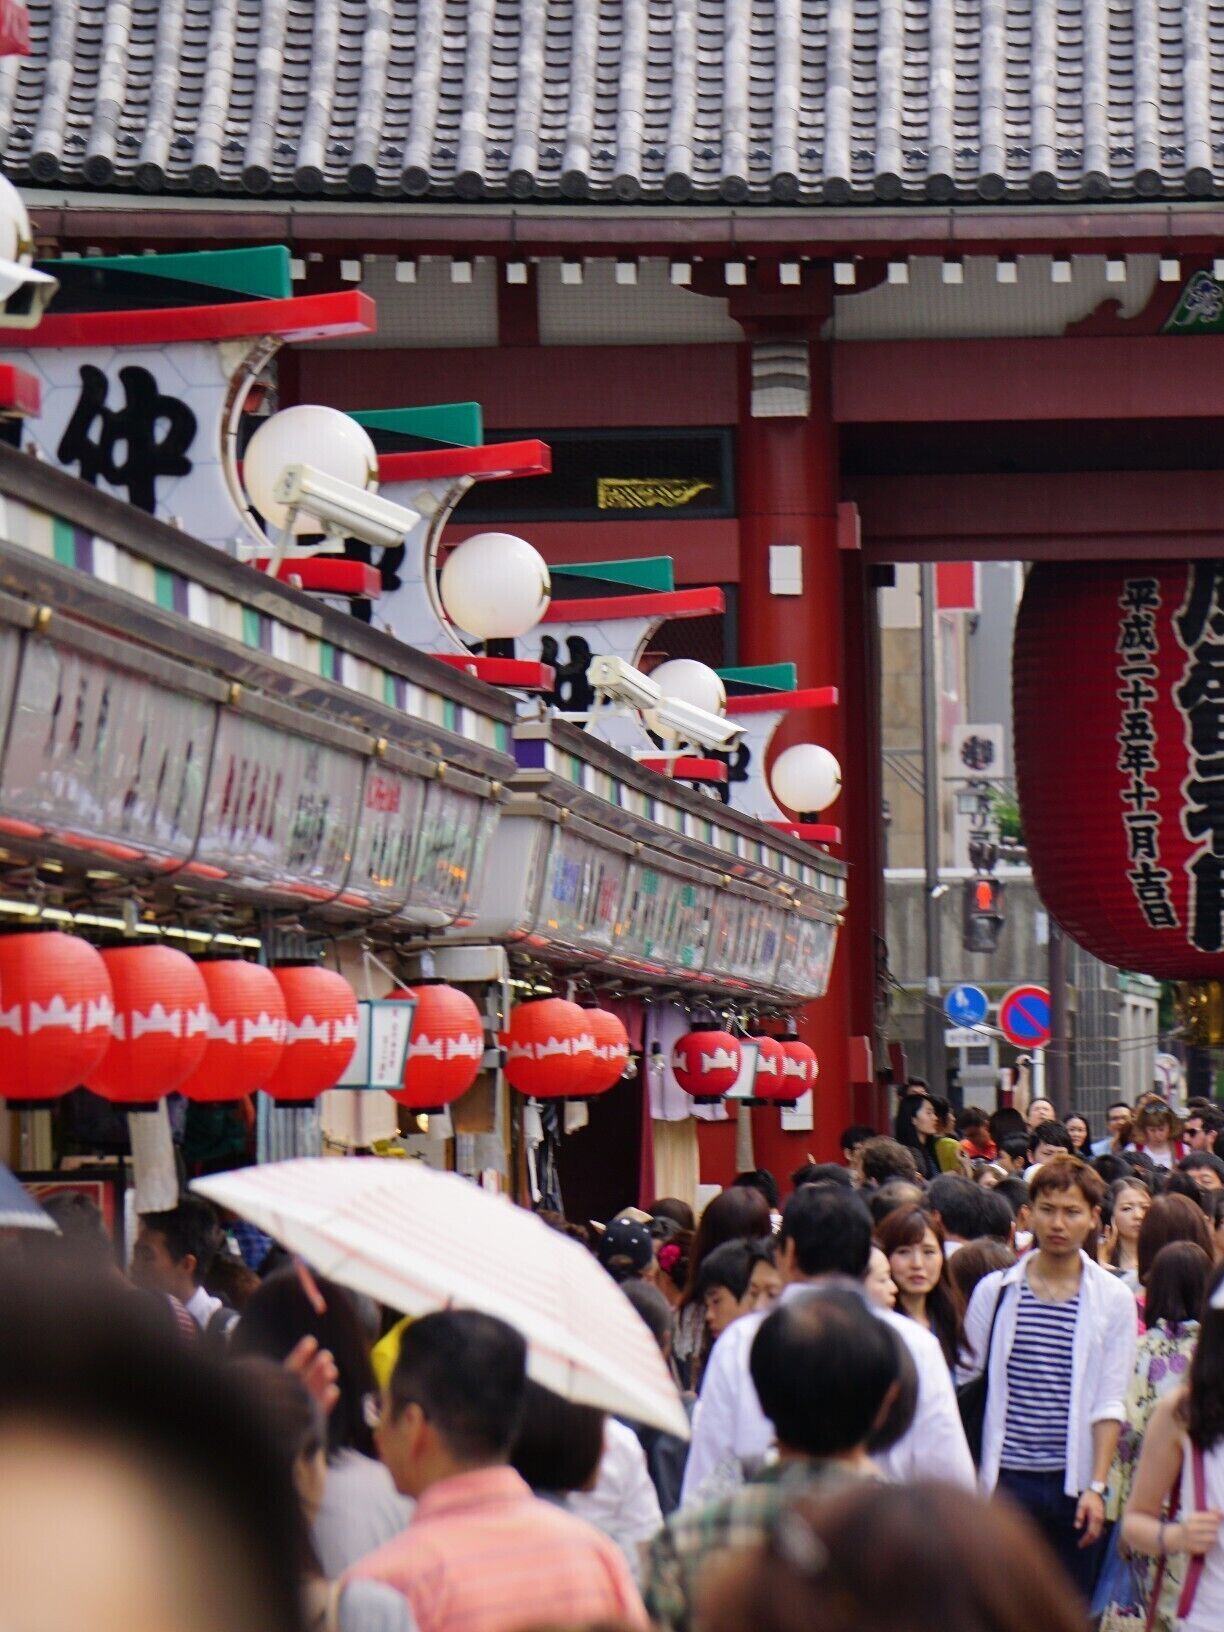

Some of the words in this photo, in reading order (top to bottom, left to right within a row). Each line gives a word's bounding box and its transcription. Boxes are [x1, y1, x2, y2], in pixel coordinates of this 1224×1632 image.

[1116, 577, 1180, 930] 平成二十五年十一月吉日
